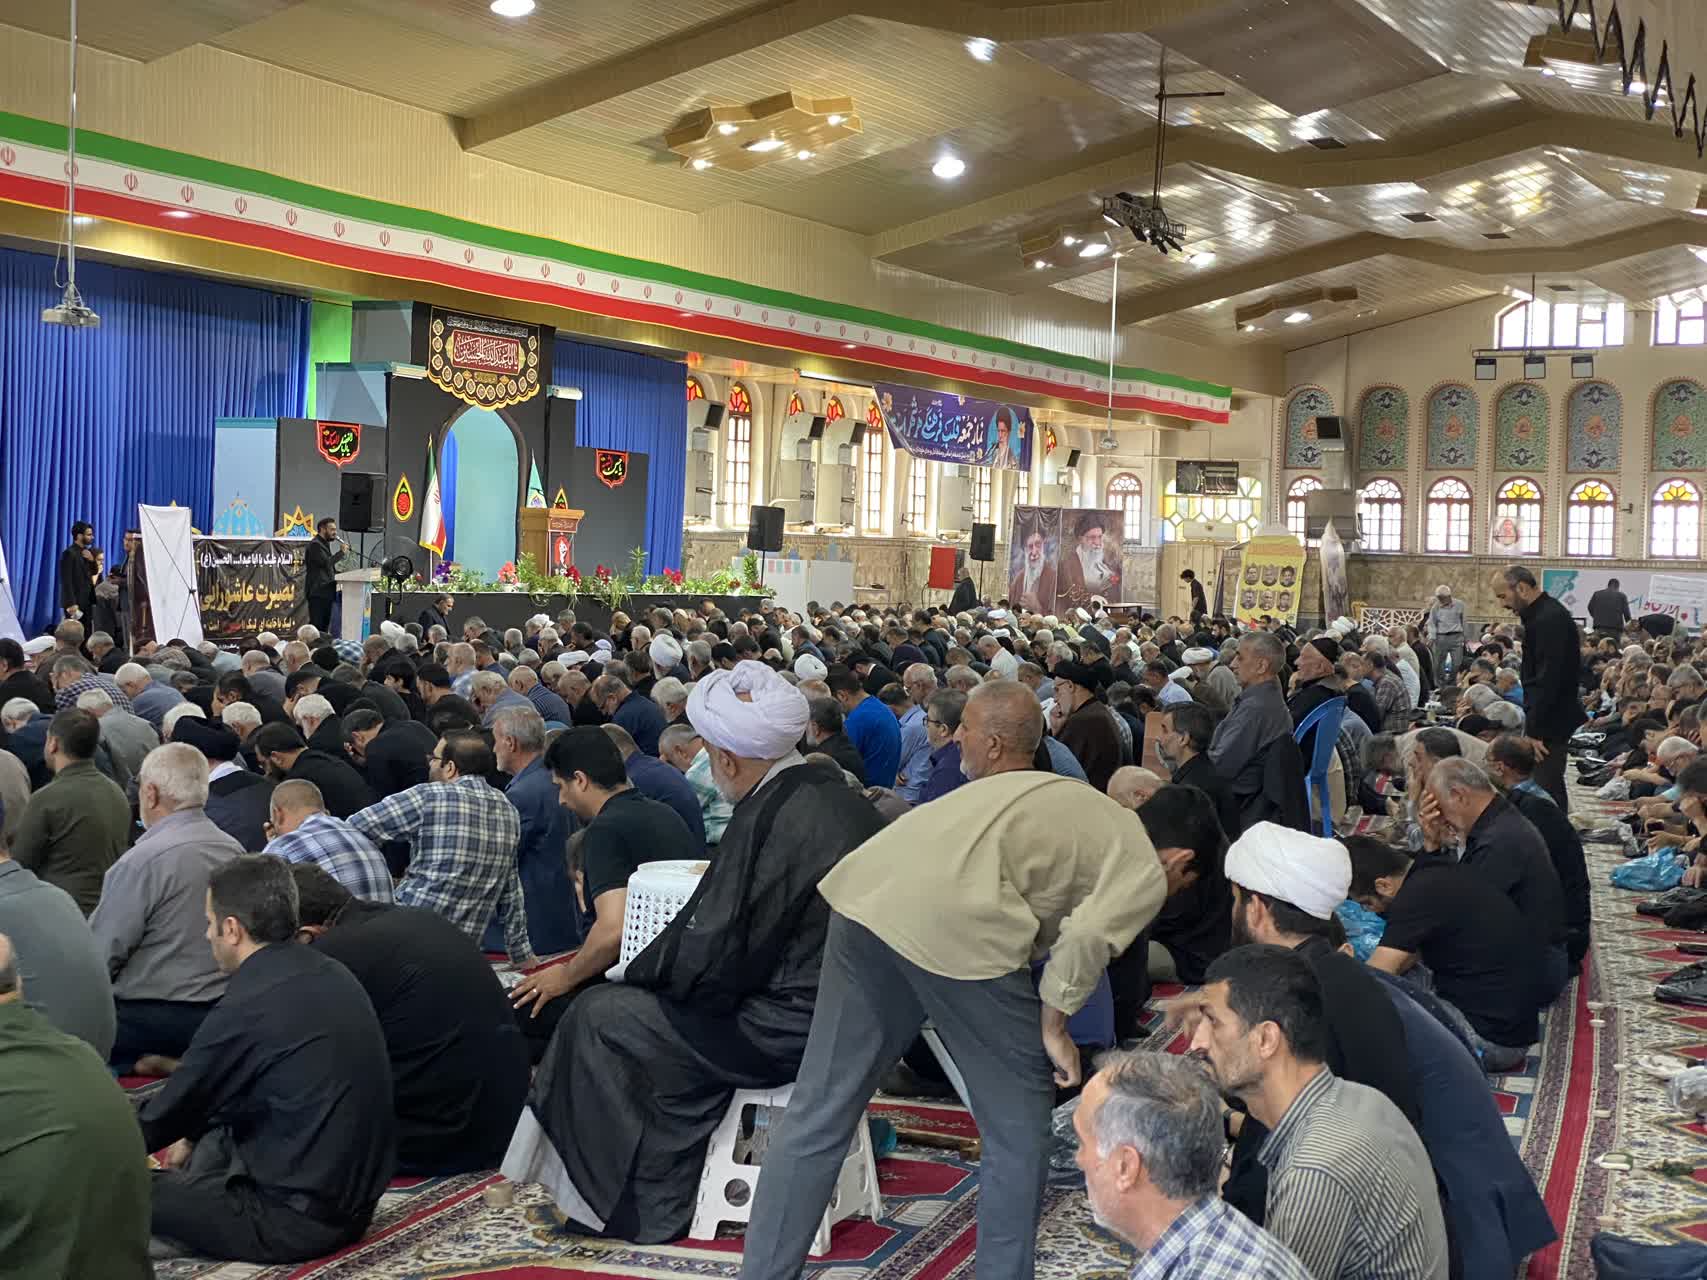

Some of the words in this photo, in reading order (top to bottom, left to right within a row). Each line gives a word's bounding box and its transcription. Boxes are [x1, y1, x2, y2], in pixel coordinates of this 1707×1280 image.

[212, 553, 232, 568] الحسین
[263, 553, 277, 567] علیک
[277, 553, 293, 568] السلام
[255, 582, 295, 610] بصیرت
